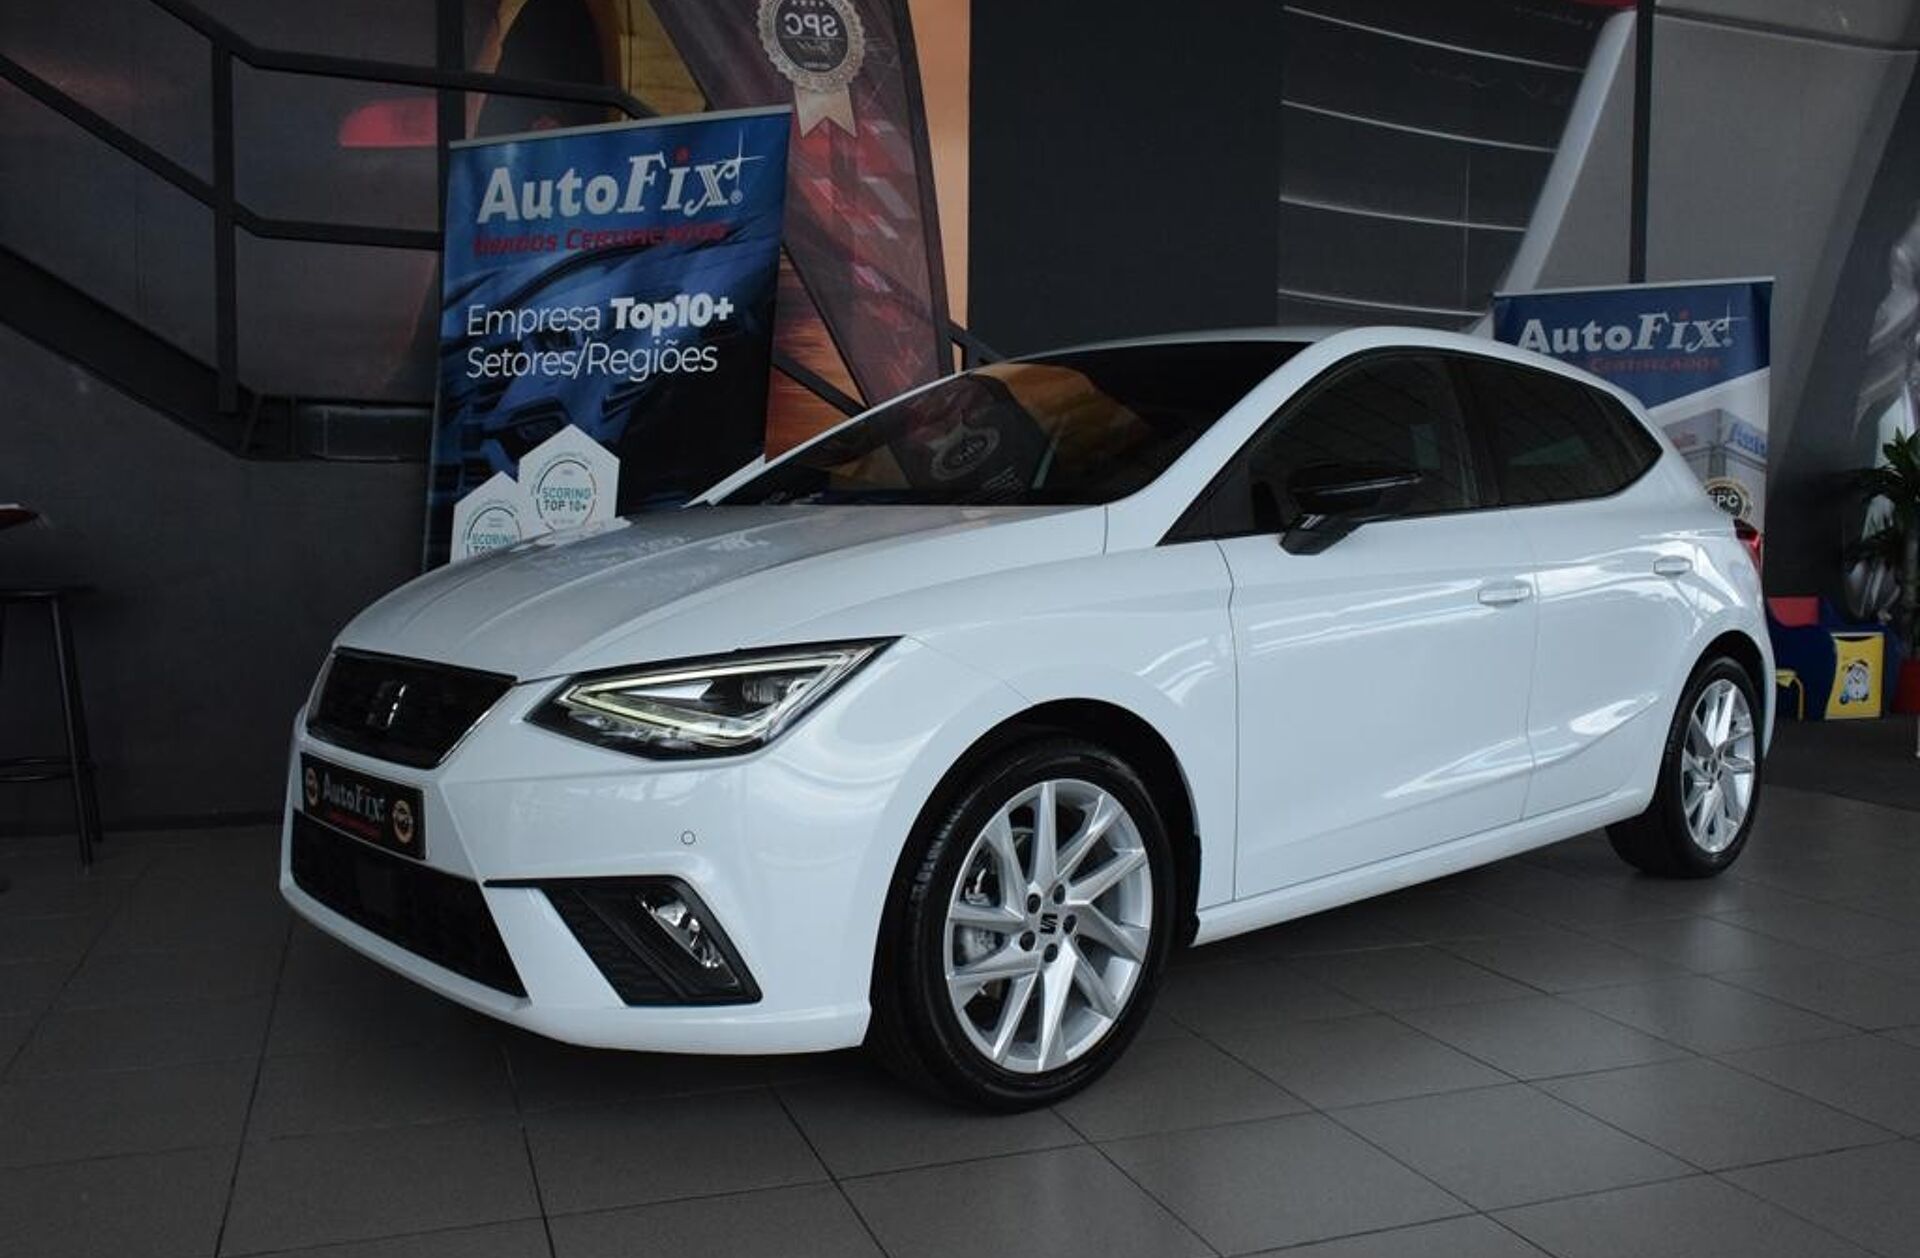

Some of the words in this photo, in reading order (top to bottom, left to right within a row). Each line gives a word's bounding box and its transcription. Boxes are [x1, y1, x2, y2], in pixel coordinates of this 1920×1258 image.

[467, 303, 601, 340] Empresa
[611, 292, 734, 334] Top10+
[466, 337, 718, 382] Setores/Regiões
[541, 487, 591, 501] SCORING
